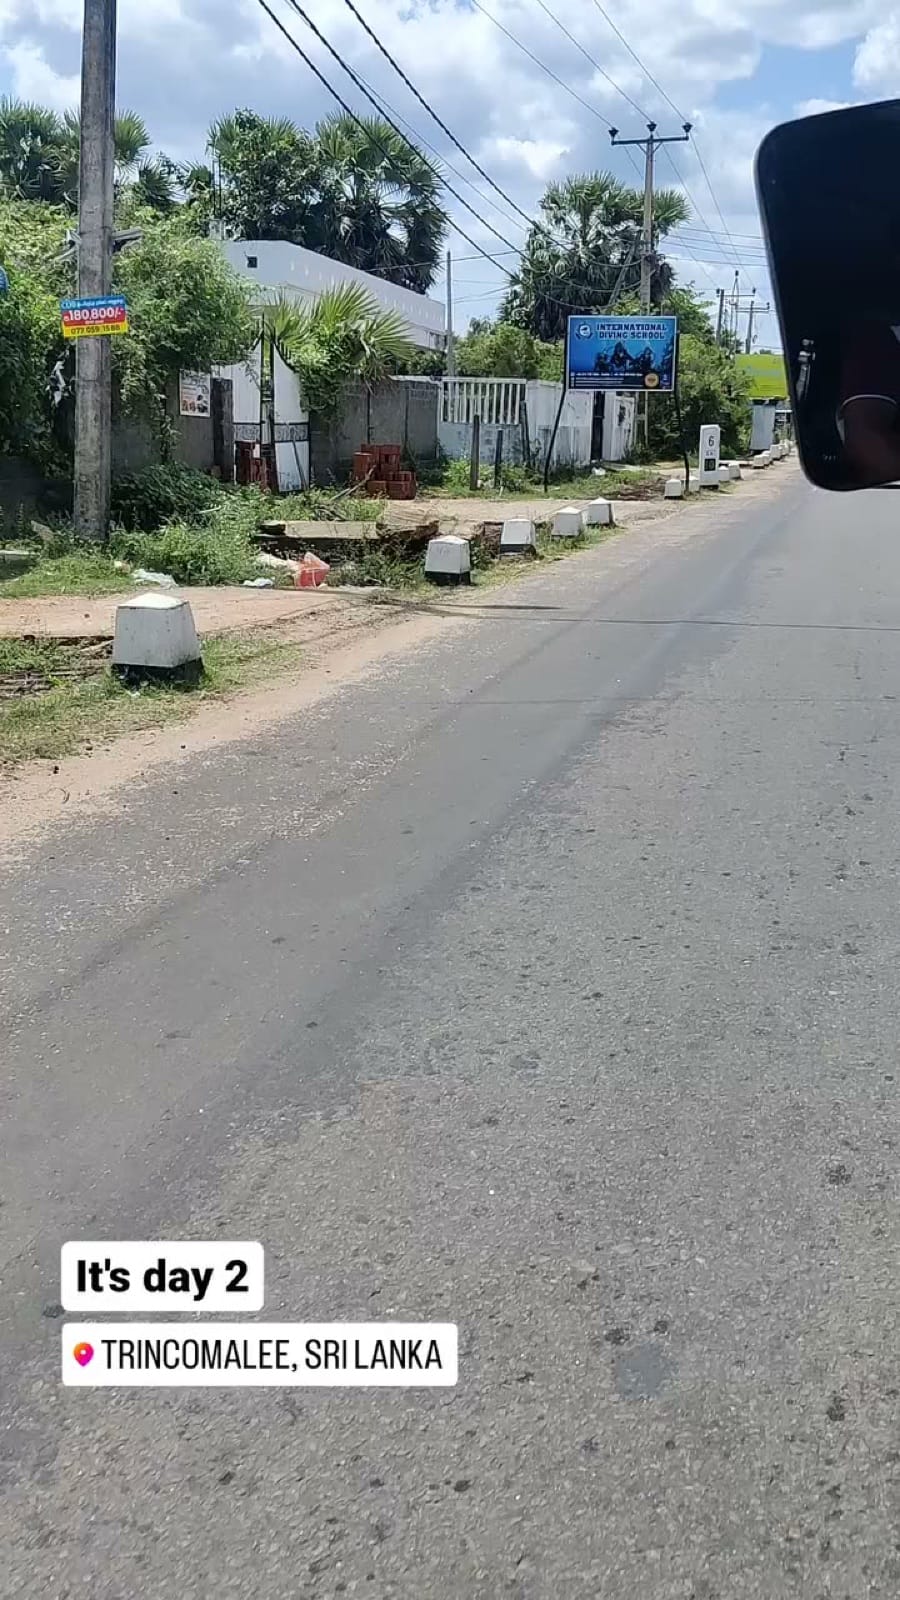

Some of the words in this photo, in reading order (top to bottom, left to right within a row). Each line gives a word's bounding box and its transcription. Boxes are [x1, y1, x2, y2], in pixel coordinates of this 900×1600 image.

[597, 323, 667, 331] INTERNATIONAL
[599, 331, 628, 340] DIVING
[630, 331, 665, 339] SCHOOL
[708, 435, 715, 447] 6
